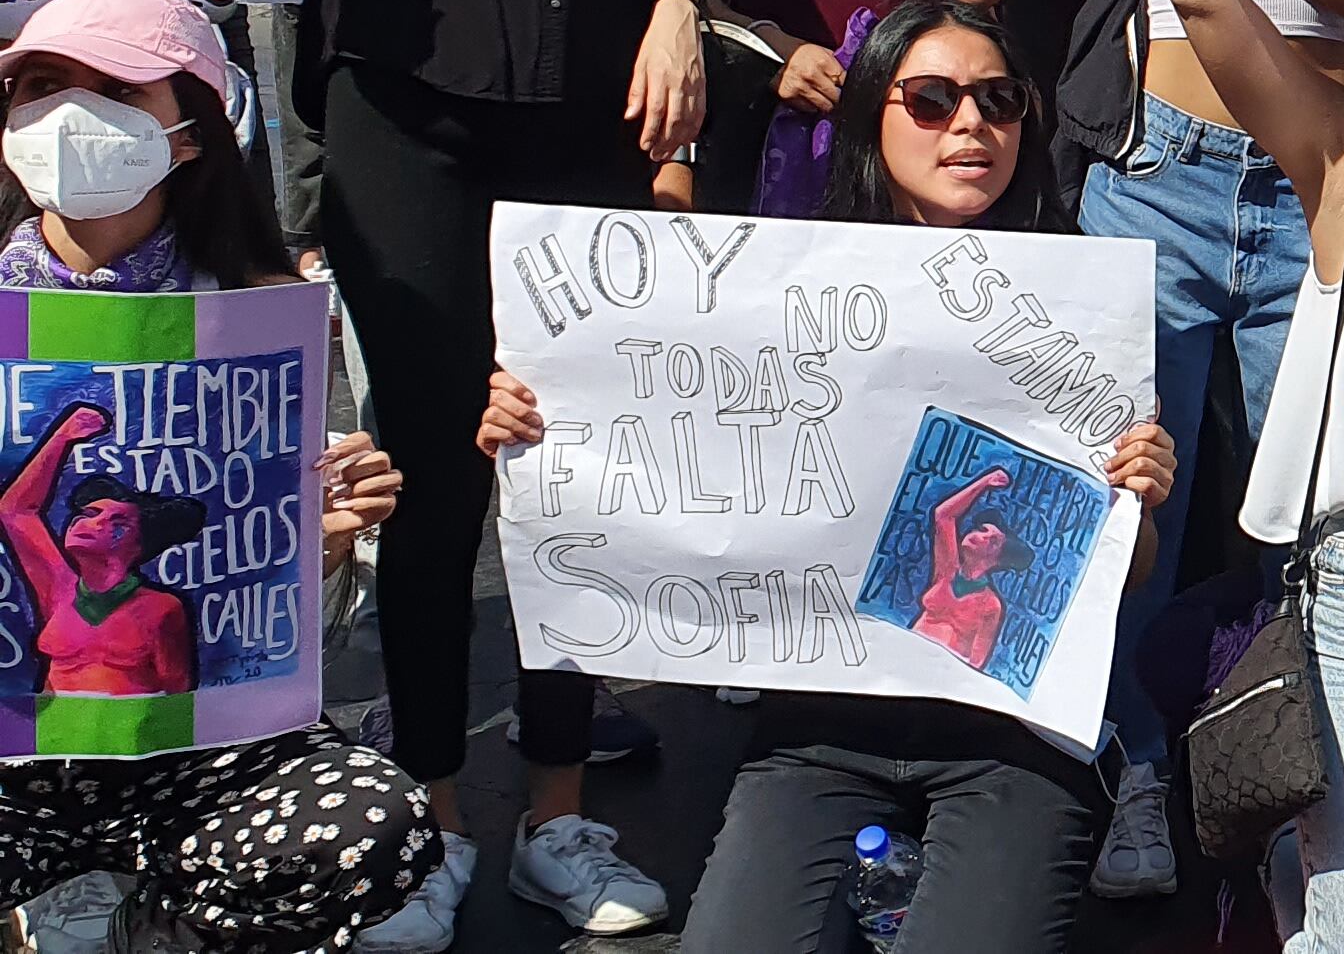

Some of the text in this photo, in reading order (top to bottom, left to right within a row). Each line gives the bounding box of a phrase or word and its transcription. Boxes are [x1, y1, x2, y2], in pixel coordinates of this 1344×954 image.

[513, 211, 756, 338] HOY
[785, 284, 888, 354] NO
[93, 361, 299, 460] TIEMBLE
[616, 338, 842, 419] TODAS
[73, 444, 255, 509] ESTADO
[541, 410, 856, 518] FALTA
[915, 417, 996, 480] QUE
[895, 472, 934, 514] EL
[159, 494, 299, 590] CIELOS
[203, 580, 301, 661] CALLES
[533, 533, 867, 666] SOFIA
